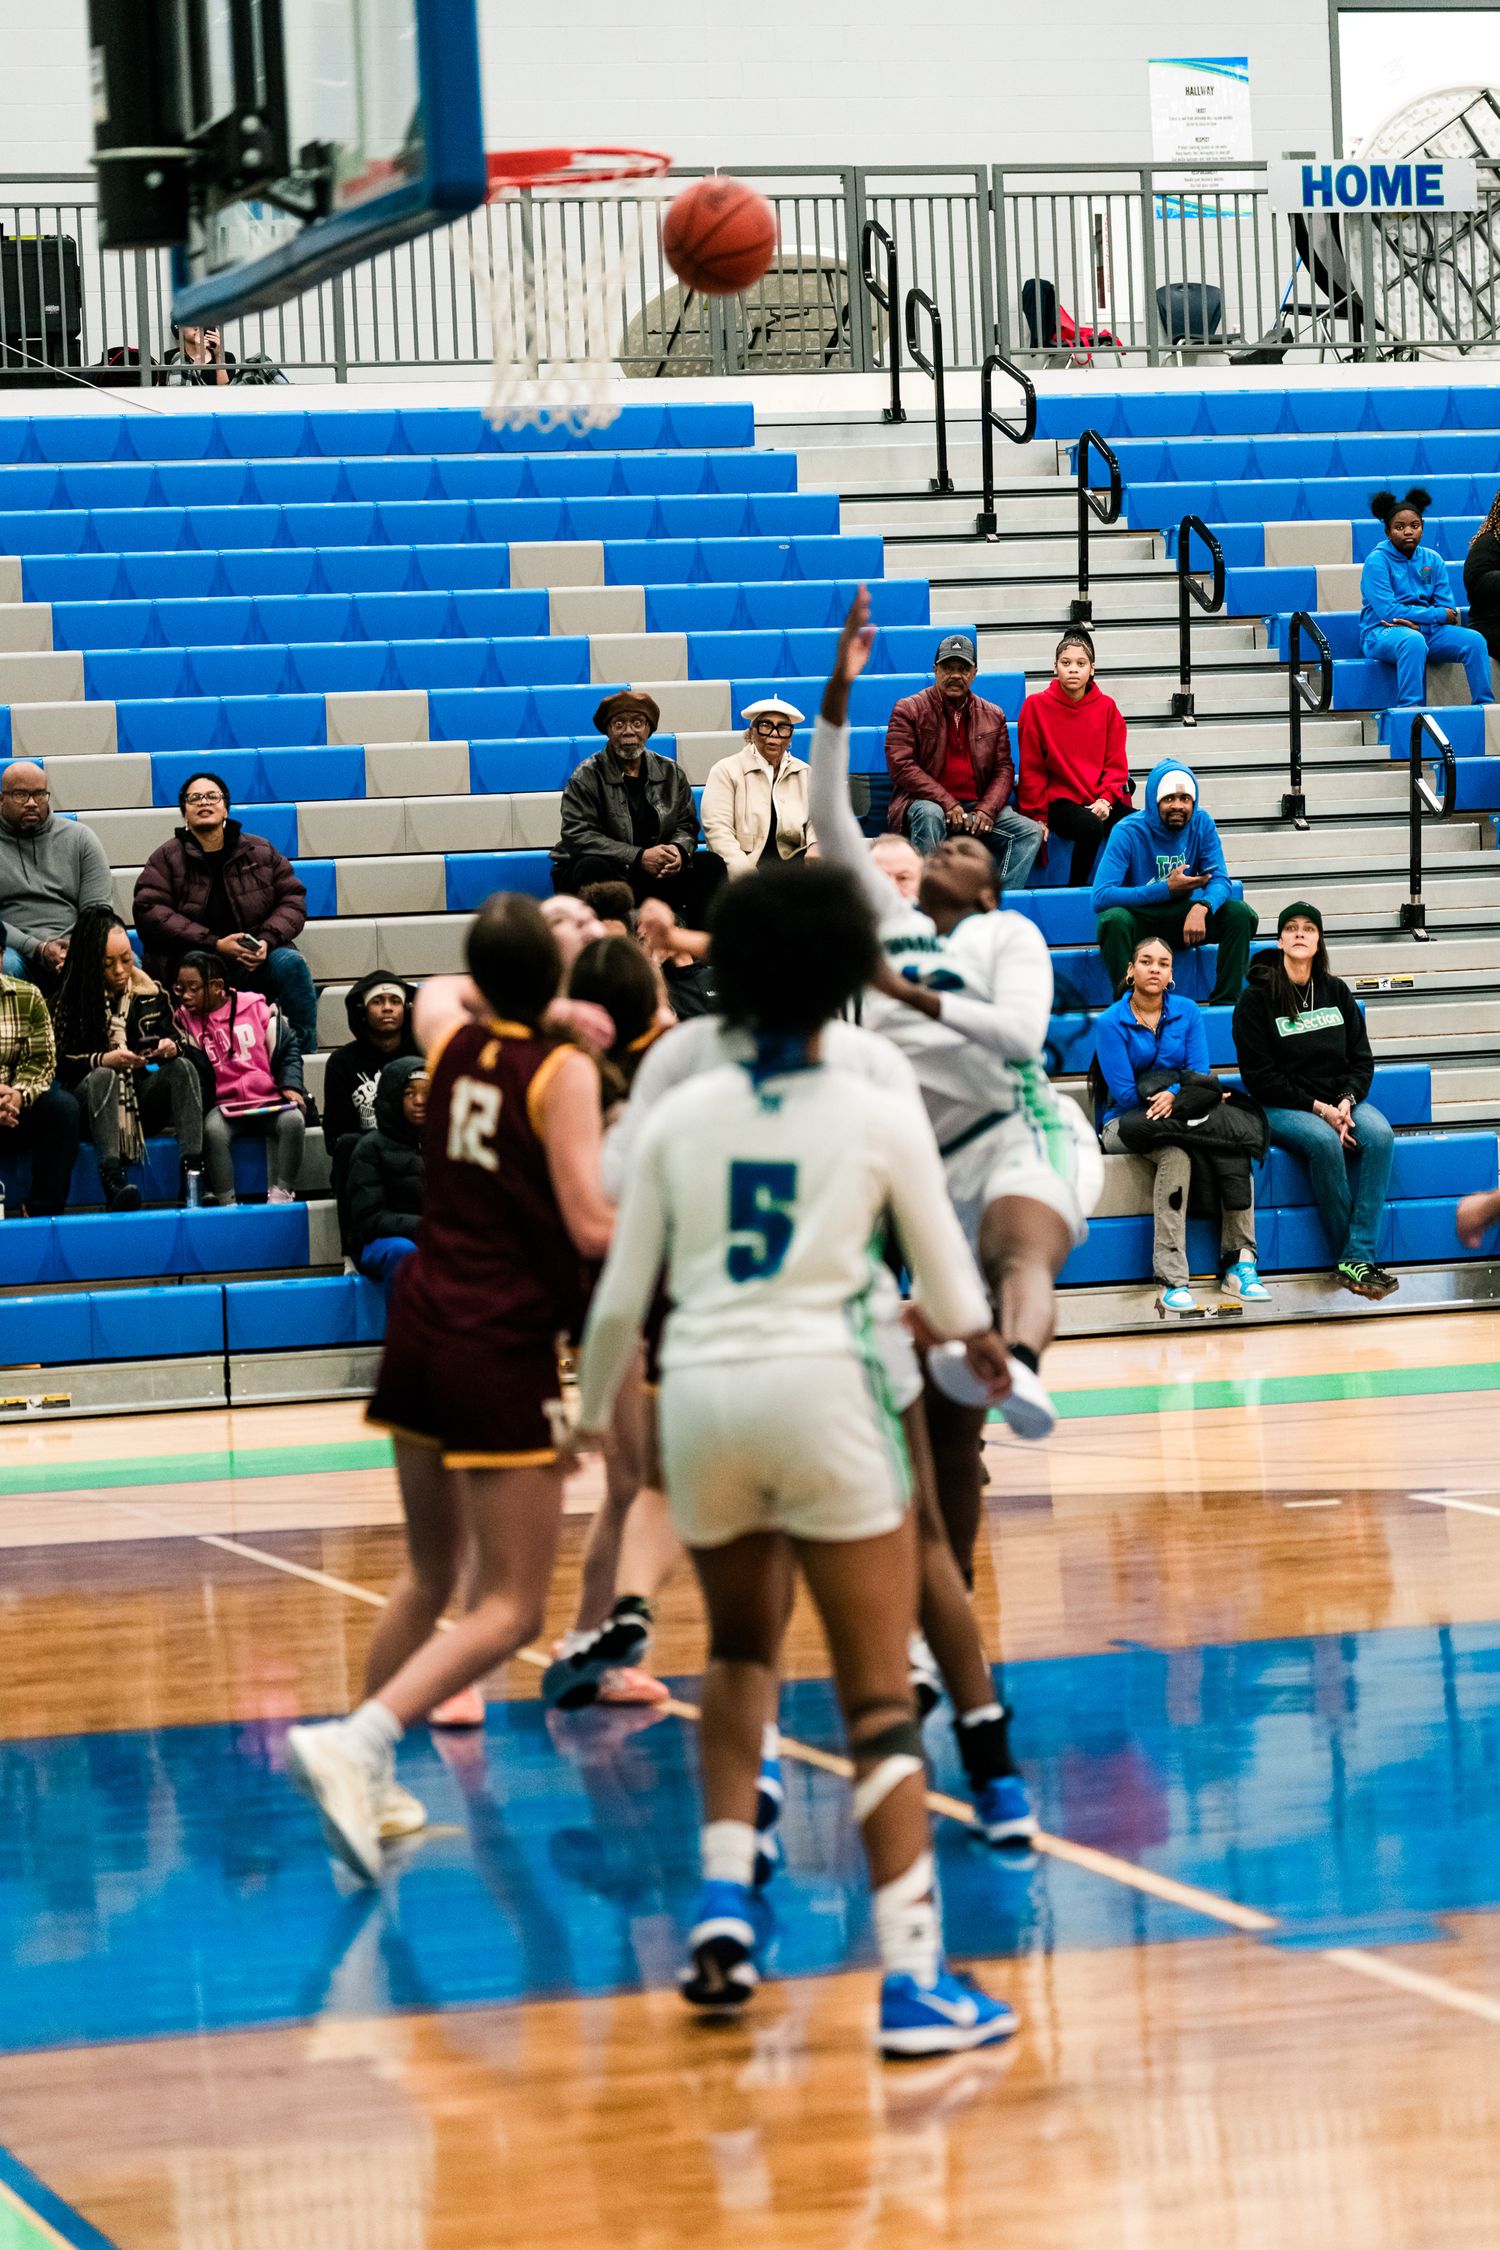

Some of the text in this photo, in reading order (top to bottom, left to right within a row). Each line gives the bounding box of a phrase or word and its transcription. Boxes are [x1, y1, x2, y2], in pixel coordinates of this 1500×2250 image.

[1185, 86, 1215, 96] HALLWAY
[1301, 164, 1445, 207] HOME
[196, 1023, 257, 1067] GAP
[447, 1075, 503, 1172] 12
[727, 1160, 798, 1283] 5
